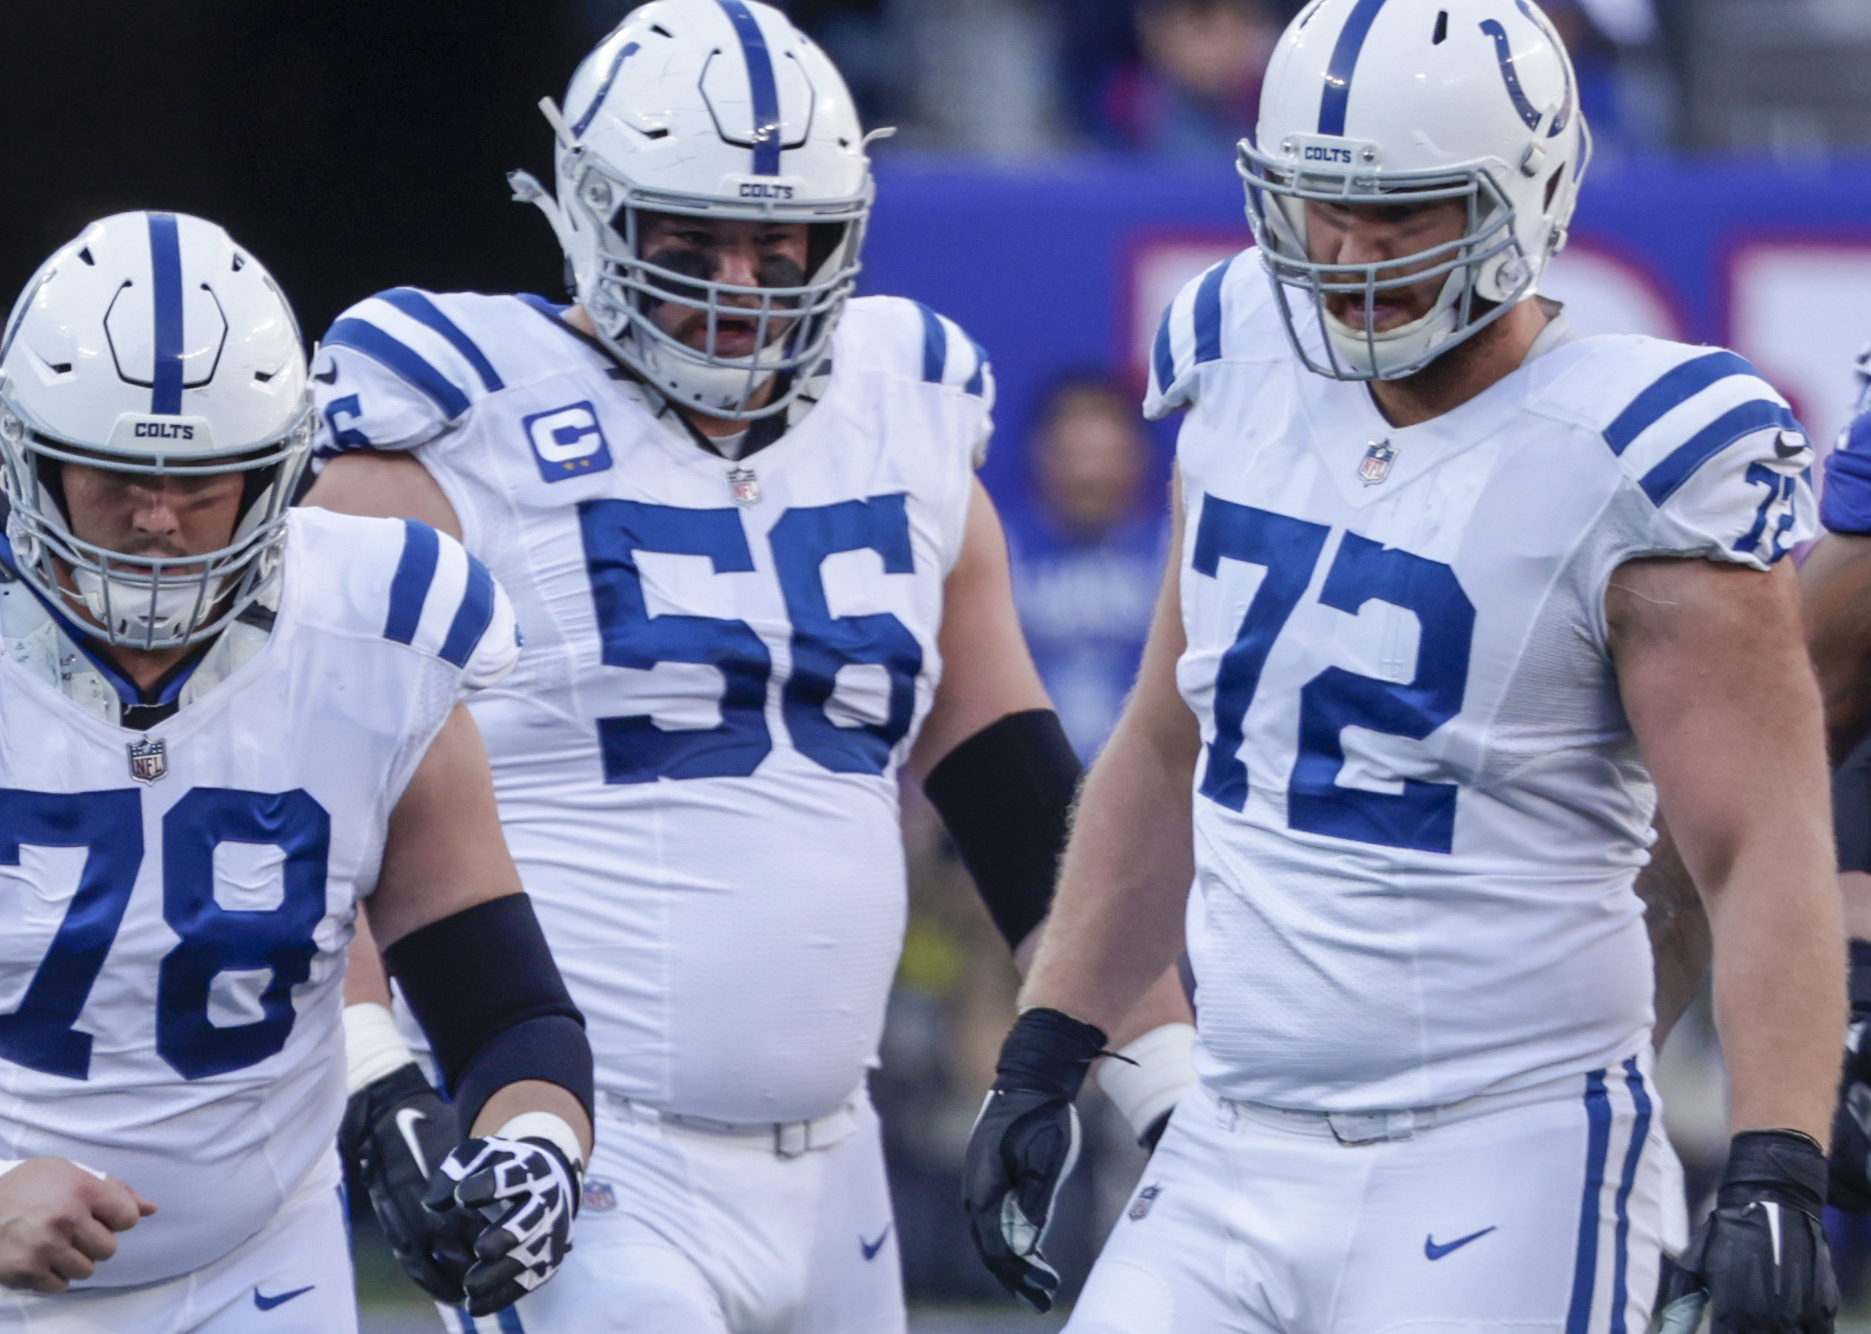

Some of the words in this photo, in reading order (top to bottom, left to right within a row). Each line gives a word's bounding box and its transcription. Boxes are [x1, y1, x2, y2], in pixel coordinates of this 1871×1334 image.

[1305, 146, 1352, 163] COLTS
[739, 183, 793, 199] COLTS
[135, 423, 194, 440] COLTS
[576, 490, 924, 785] 56
[1191, 490, 1479, 855] 72
[133, 756, 164, 776] NFL
